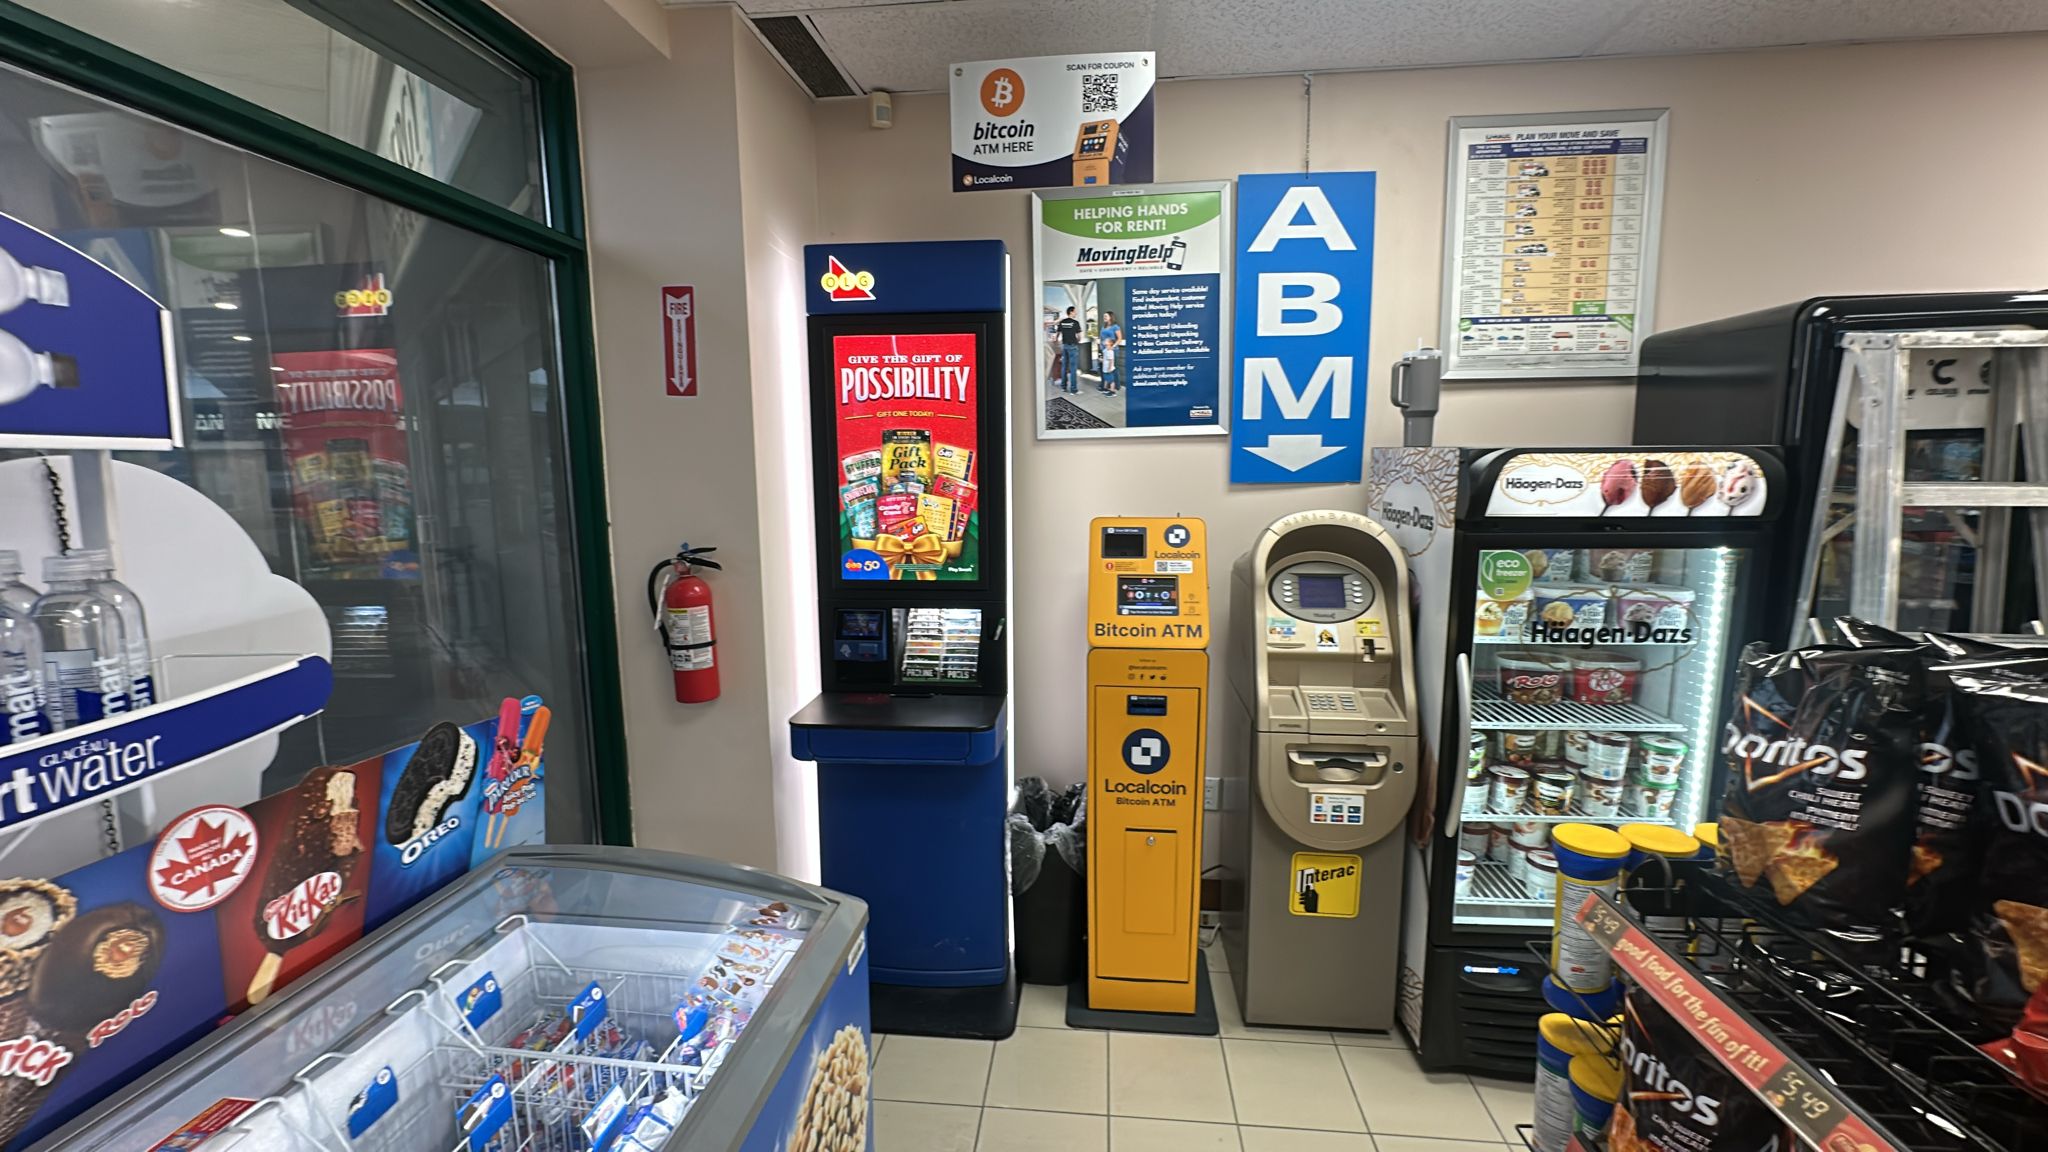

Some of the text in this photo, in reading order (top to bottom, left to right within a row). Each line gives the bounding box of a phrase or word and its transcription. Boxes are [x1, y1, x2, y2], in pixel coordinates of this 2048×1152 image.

[1066, 63, 1086, 71] SCAN
[1103, 61, 1135, 69] COUPON
[973, 120, 1035, 140] bitcoin
[973, 141, 1034, 155] ATM HERE
[974, 174, 1014, 184] Localcoin
[1074, 203, 1188, 220] HELPING HANDS
[1095, 219, 1167, 234] FOR RENT!
[1077, 244, 1174, 264] MovingHelp
[824, 273, 871, 290] OLG
[1243, 186, 1357, 419] ABM
[848, 354, 963, 364] GIVE THE GIFT OF
[841, 366, 970, 405] POSSIBILITY
[893, 446, 920, 458] Gift
[889, 457, 926, 470] Pack
[1505, 477, 1583, 492] Häagen-Dazs
[1154, 551, 1200, 559] Localcoin
[863, 561, 880, 571] 50
[1095, 623, 1202, 638] Bitcoin ATM
[1105, 779, 1186, 795] Localcoin
[1816, 787, 1861, 800] SWEET
[1116, 797, 1175, 806] Bitcoin ATM
[401, 817, 460, 864] OREO
[170, 849, 243, 885] CANADA
[1300, 864, 1355, 892] Interac
[276, 874, 338, 938] KitKat
[1613, 939, 1769, 1072] good food for the fun of it!
